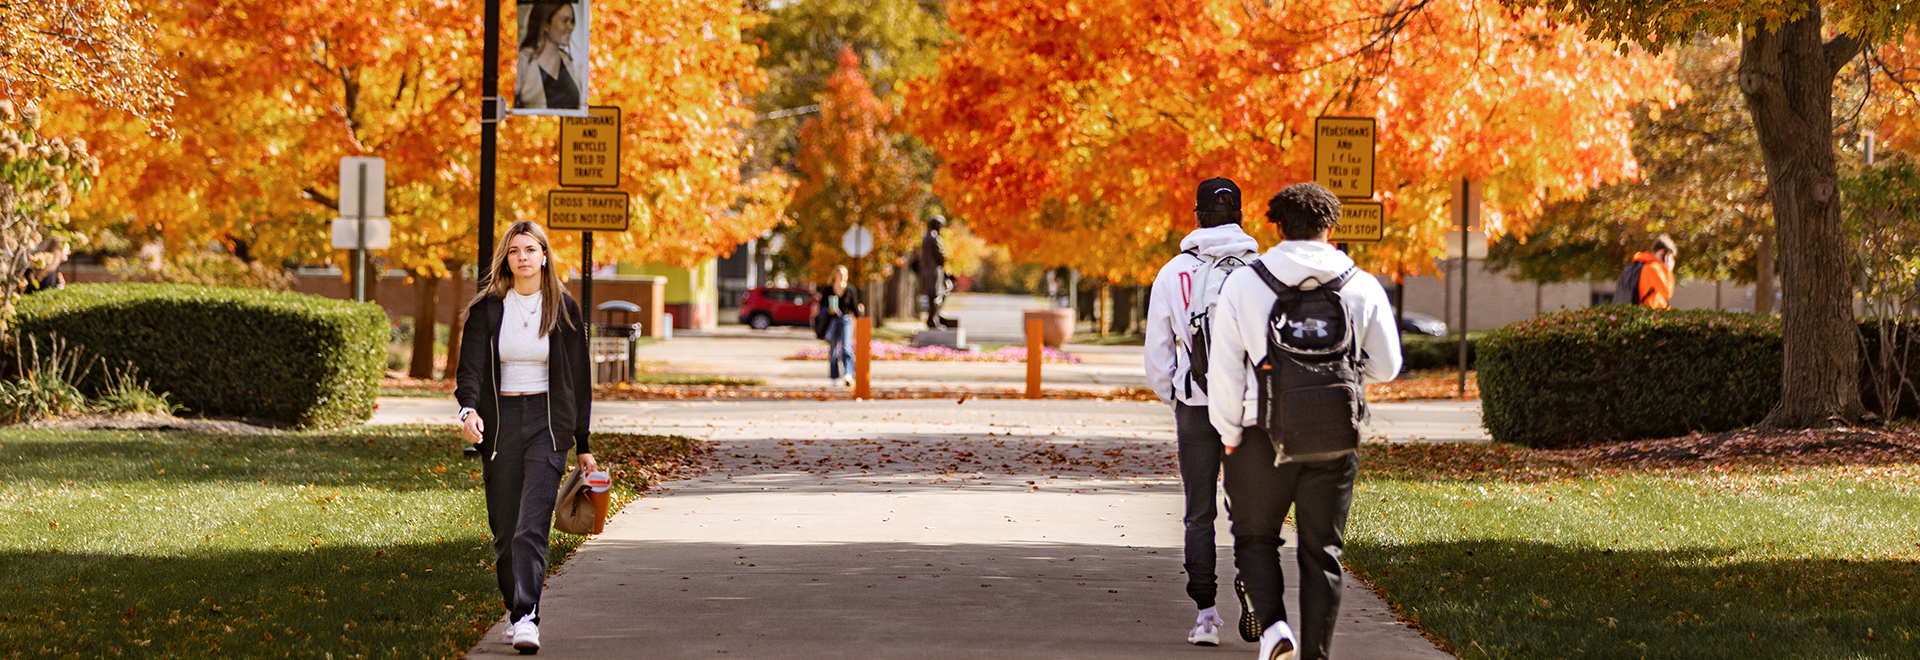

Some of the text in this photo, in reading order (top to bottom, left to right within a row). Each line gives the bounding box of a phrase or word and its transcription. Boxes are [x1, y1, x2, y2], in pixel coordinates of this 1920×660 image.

[566, 115, 615, 126] PEDESTRIANS
[582, 128, 598, 138] AND
[1321, 126, 1369, 138] PEDESTRIANS
[572, 141, 607, 152] BICYCLES
[1336, 140, 1353, 150] AND
[573, 154, 606, 165] YIELD TO
[574, 167, 604, 178] TRAFFIC
[1328, 165, 1348, 177] YIELD
[1329, 179, 1358, 190] TRAIC
[553, 197, 624, 209] CROSS TRAFFIC
[552, 212, 624, 224] DOES NOT STOP
[1342, 208, 1378, 220] TRAFFIC
[1335, 224, 1378, 236] NOT STOP
